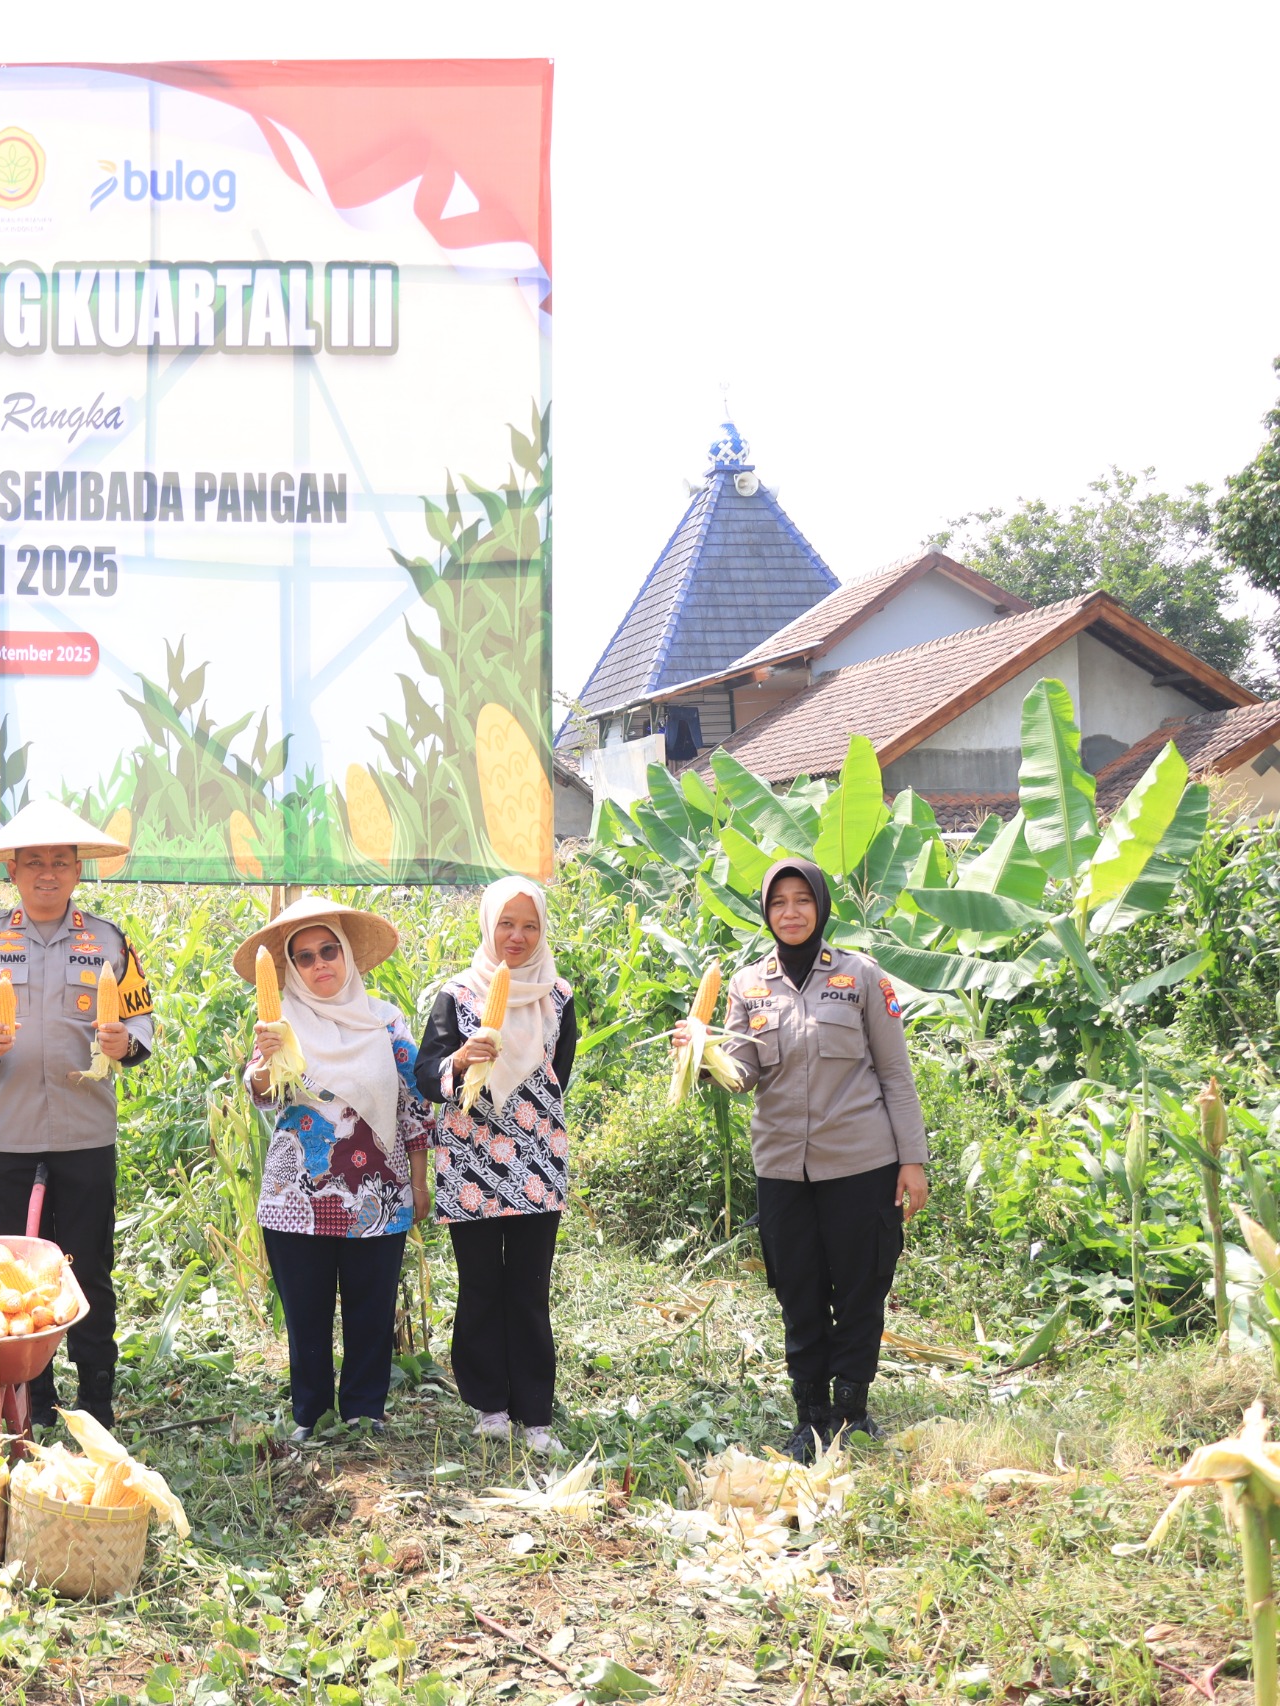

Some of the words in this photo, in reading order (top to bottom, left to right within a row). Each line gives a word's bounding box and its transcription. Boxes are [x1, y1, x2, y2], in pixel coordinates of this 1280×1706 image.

[123, 158, 238, 213] bulog
[52, 262, 322, 354] KUARTAL
[325, 262, 399, 355] III
[1, 391, 124, 444] Rangka
[194, 471, 348, 524] PANGAN
[16, 544, 119, 598] 2025
[56, 646, 92, 663] 2025
[69, 955, 105, 966] POLRI
[821, 991, 860, 1004] POLRI
